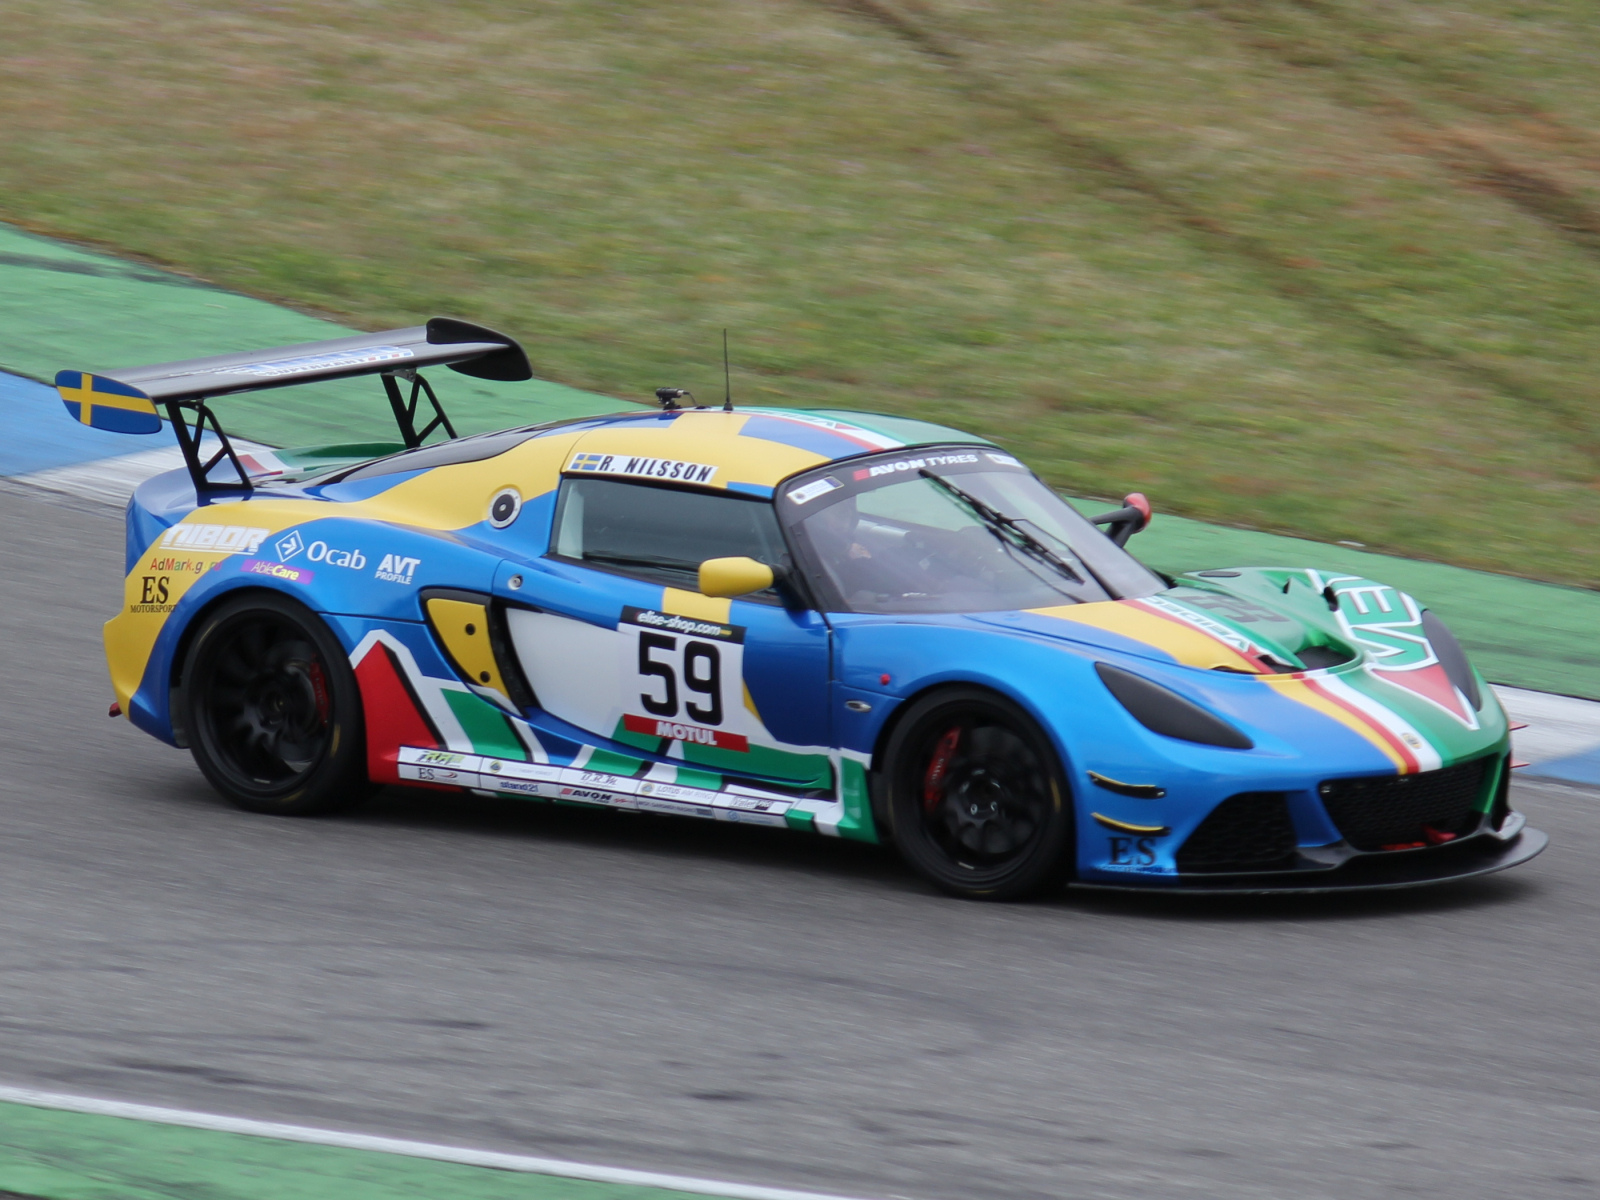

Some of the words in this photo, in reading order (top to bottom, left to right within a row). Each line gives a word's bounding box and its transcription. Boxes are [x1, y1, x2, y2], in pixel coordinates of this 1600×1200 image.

[599, 455, 616, 472] R.
[624, 457, 713, 482] NILSSON
[868, 459, 926, 477] AVON
[926, 453, 979, 468] TYRES
[160, 522, 270, 554] NIBOR
[306, 540, 367, 570] Ocab
[377, 553, 421, 577] AVT
[250, 561, 300, 581] AbleCare
[374, 570, 413, 585] PROFILE
[140, 575, 170, 604] ES
[130, 604, 178, 613] MOTORSPORT
[637, 611, 721, 636] elise-shop.com
[638, 630, 723, 726] 59
[656, 720, 718, 746] MOTUL
[418, 767, 435, 780] ES
[572, 789, 613, 801] AVON
[1107, 836, 1156, 866] ES
